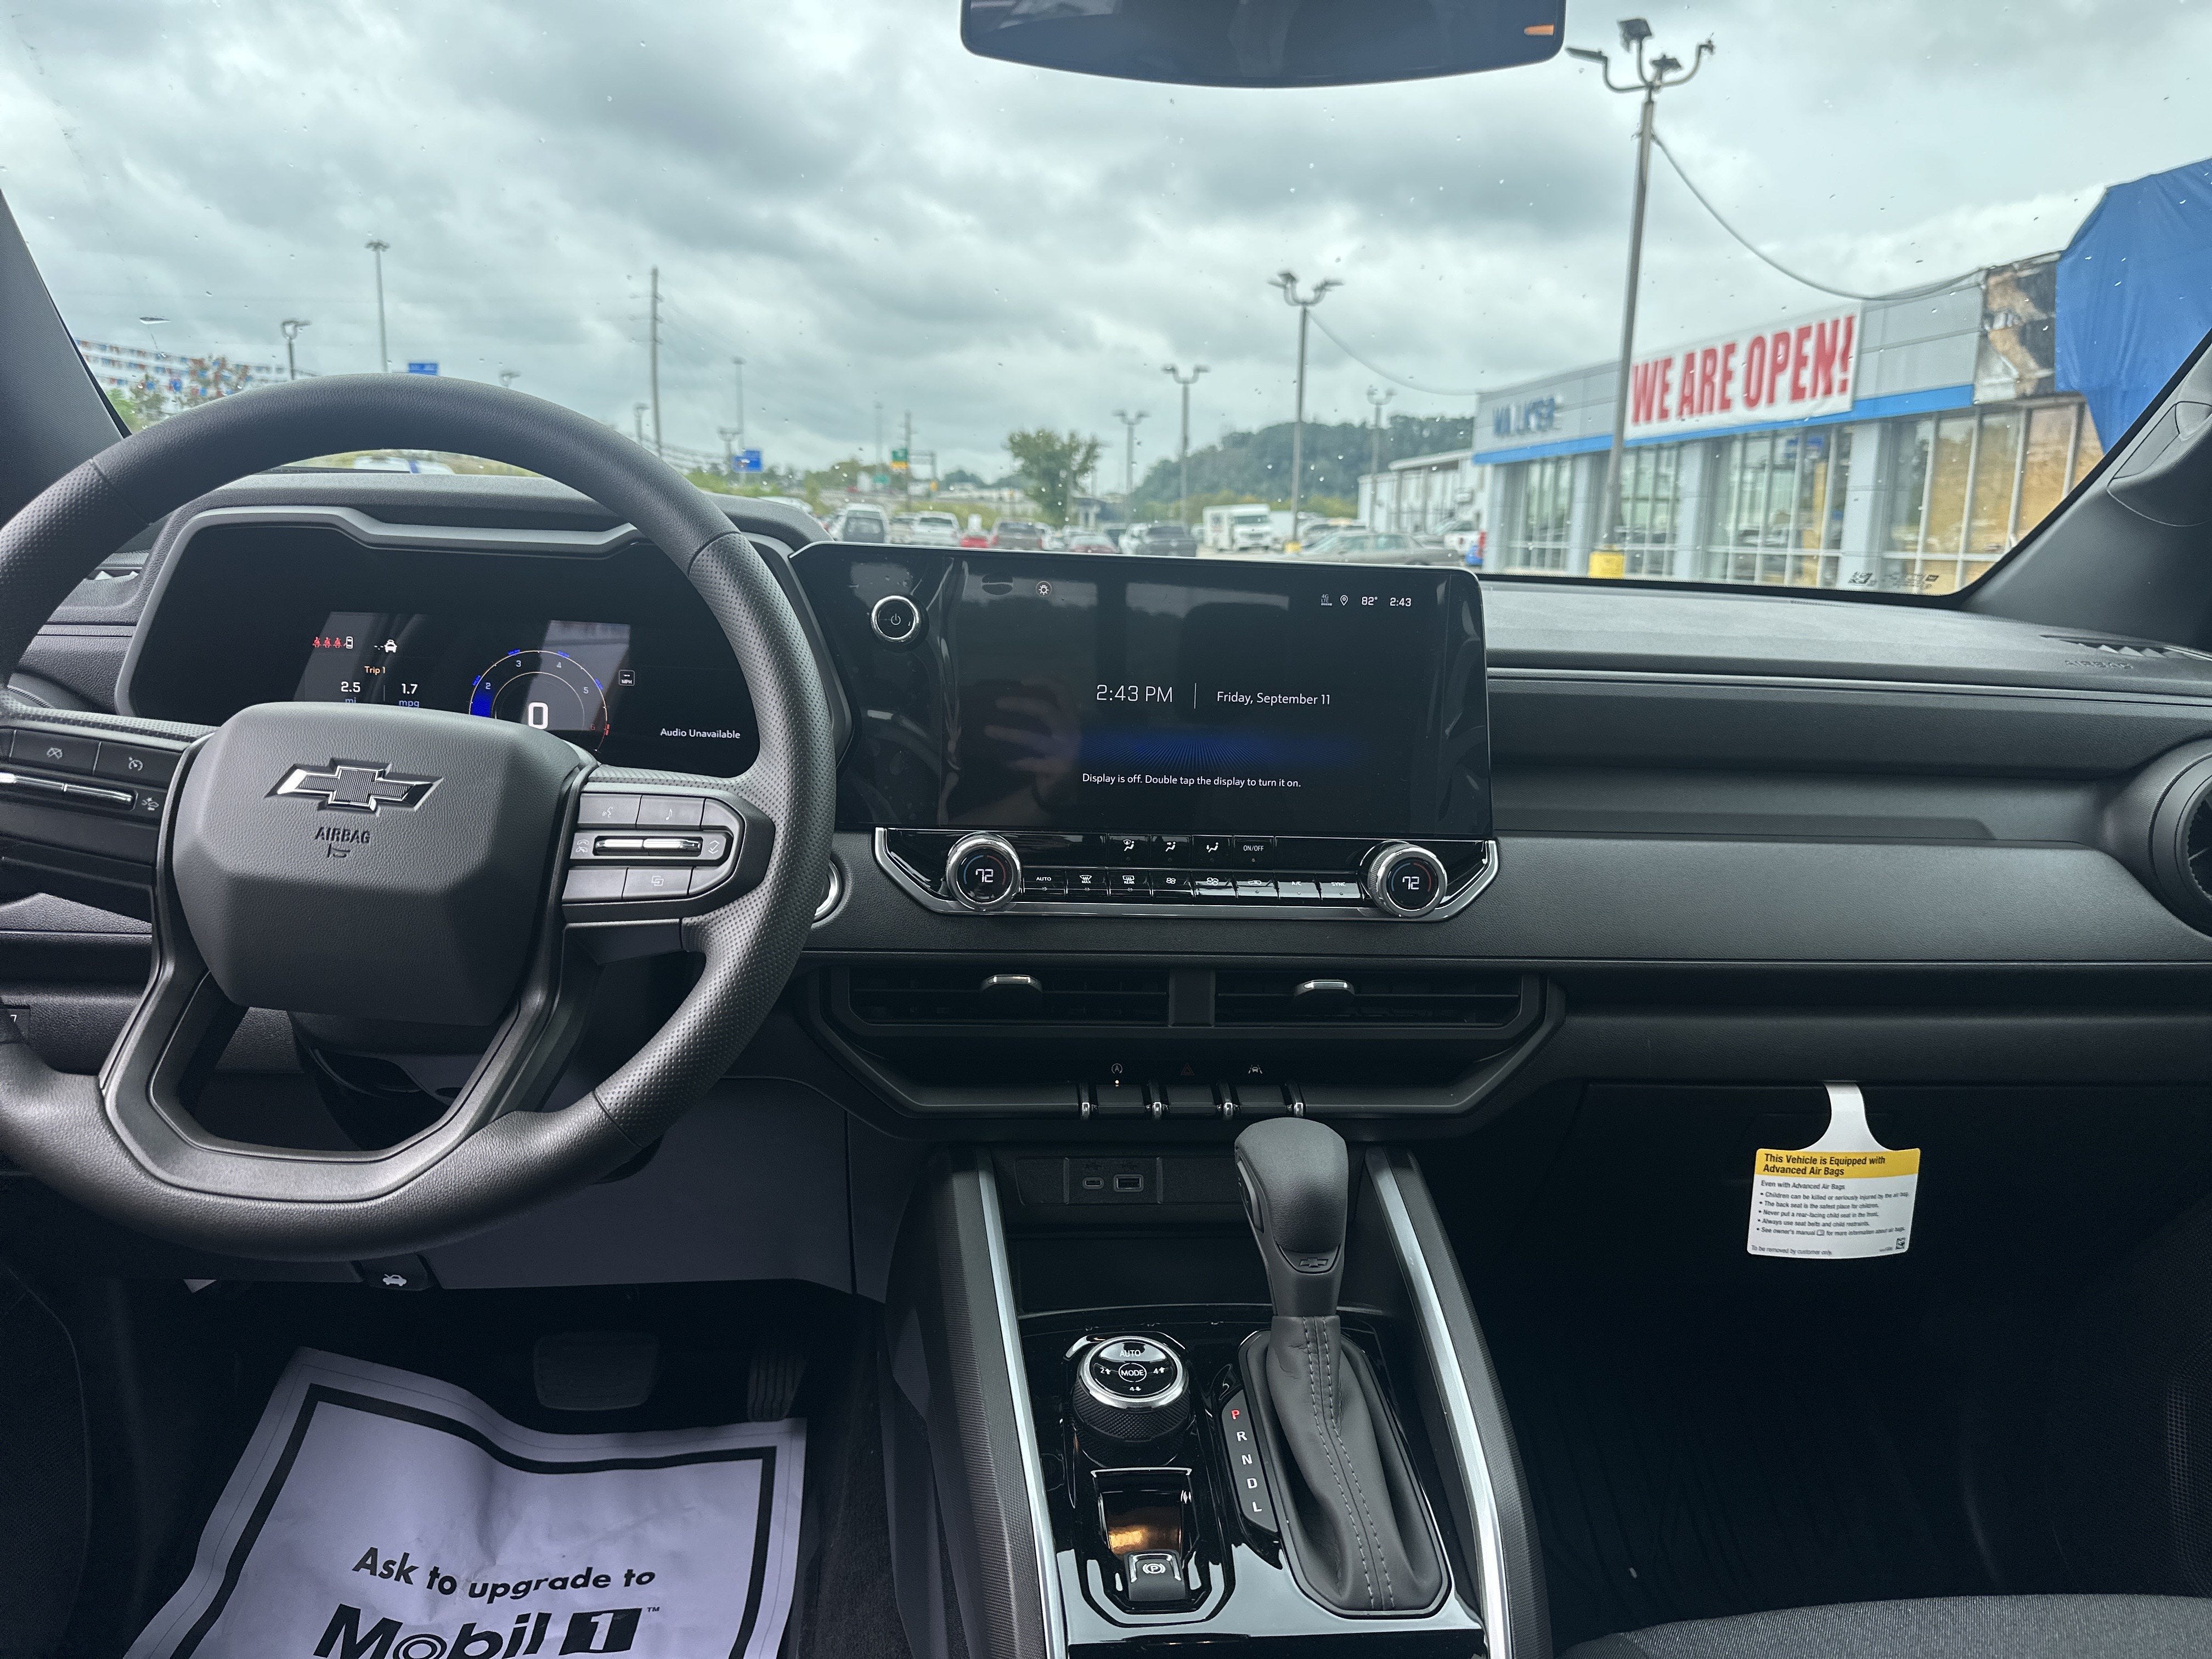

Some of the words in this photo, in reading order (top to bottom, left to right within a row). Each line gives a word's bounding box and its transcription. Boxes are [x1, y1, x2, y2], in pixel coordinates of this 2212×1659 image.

[1631, 358, 1672, 425] WE
[1677, 342, 1737, 419] ARE
[1742, 315, 1855, 410] OPEN!
[1390, 597, 1412, 606] 2:43
[364, 665, 380, 675] Trip
[341, 681, 360, 692] 2.5
[402, 684, 418, 694] 1.7
[1096, 684, 1138, 702] 2:43
[1146, 686, 1173, 702] PM
[1217, 691, 1252, 705] Friday,
[1257, 692, 1318, 706] September
[1321, 694, 1330, 704] 11
[528, 702, 548, 729] 0
[660, 728, 686, 737] Audio
[689, 729, 741, 738] Unavailable
[1082, 773, 1115, 785] Display
[1118, 774, 1125, 783] is
[1127, 774, 1143, 783] off.
[1145, 775, 1177, 784] Double
[1180, 776, 1194, 786] tap
[1197, 776, 1211, 785] the
[1214, 776, 1245, 788] display
[1247, 778, 1256, 786] to
[1259, 778, 1277, 787] turn
[1279, 778, 1285, 787] it
[314, 826, 371, 844] AIRBAG
[975, 868, 994, 883] 72
[1403, 876, 1420, 890] 72
[1764, 1153, 1783, 1163] This
[1786, 1155, 1817, 1165] Vehicle
[1820, 1156, 1827, 1165] is
[1829, 1156, 1867, 1166] Equipped
[1869, 1156, 1886, 1164] with
[1763, 1164, 1807, 1175] Advanced
[1809, 1166, 1822, 1175] Air
[1824, 1167, 1844, 1177] Bags
[1231, 1409, 1240, 1419] P
[1237, 1430, 1248, 1442] R
[1242, 1454, 1252, 1465] N
[1247, 1477, 1258, 1489] D
[1252, 1501, 1262, 1513] L
[352, 1547, 420, 1585] Ask
[426, 1566, 458, 1595] to
[467, 1566, 612, 1605] upgrade
[623, 1567, 656, 1587] to
[313, 1602, 552, 1659] Mobil
